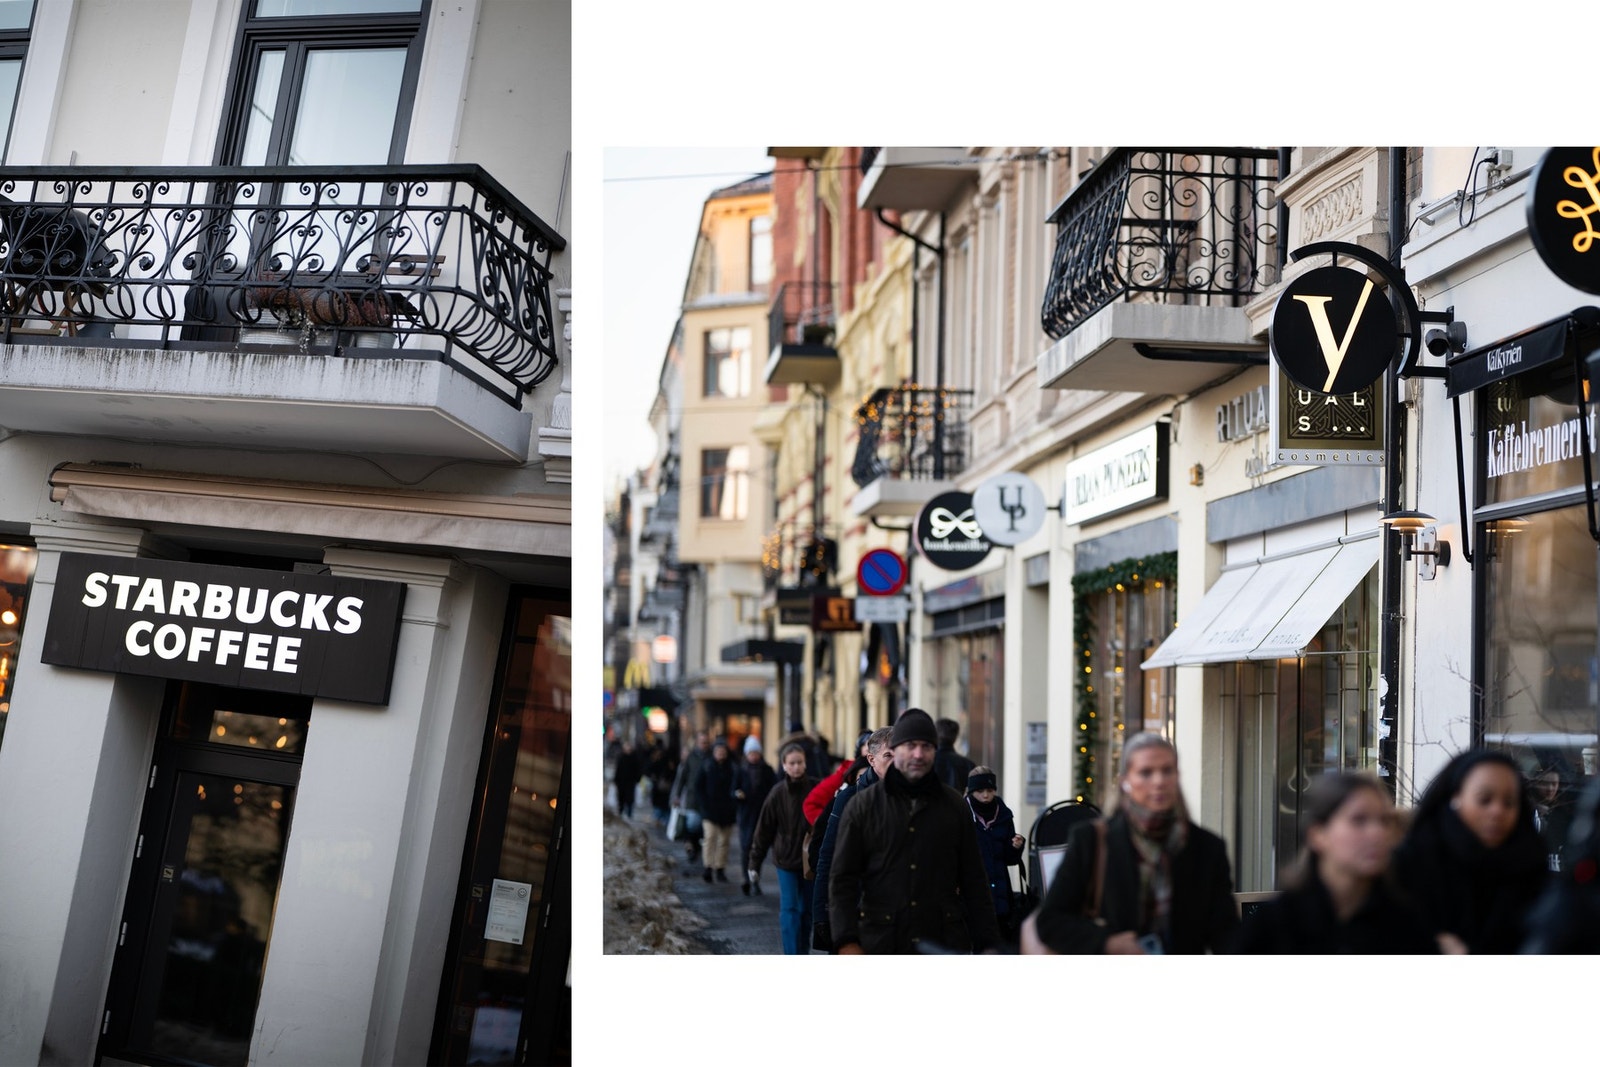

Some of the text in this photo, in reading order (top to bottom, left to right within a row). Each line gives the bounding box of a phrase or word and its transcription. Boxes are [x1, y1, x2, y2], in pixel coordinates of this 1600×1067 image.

[1487, 342, 1522, 374] Valkyrien
[1278, 452, 1385, 462] cosmetics
[1487, 403, 1597, 478] Kaffebrennerit
[81, 572, 364, 634] STARBUCKS
[124, 620, 302, 674] COFFEE
